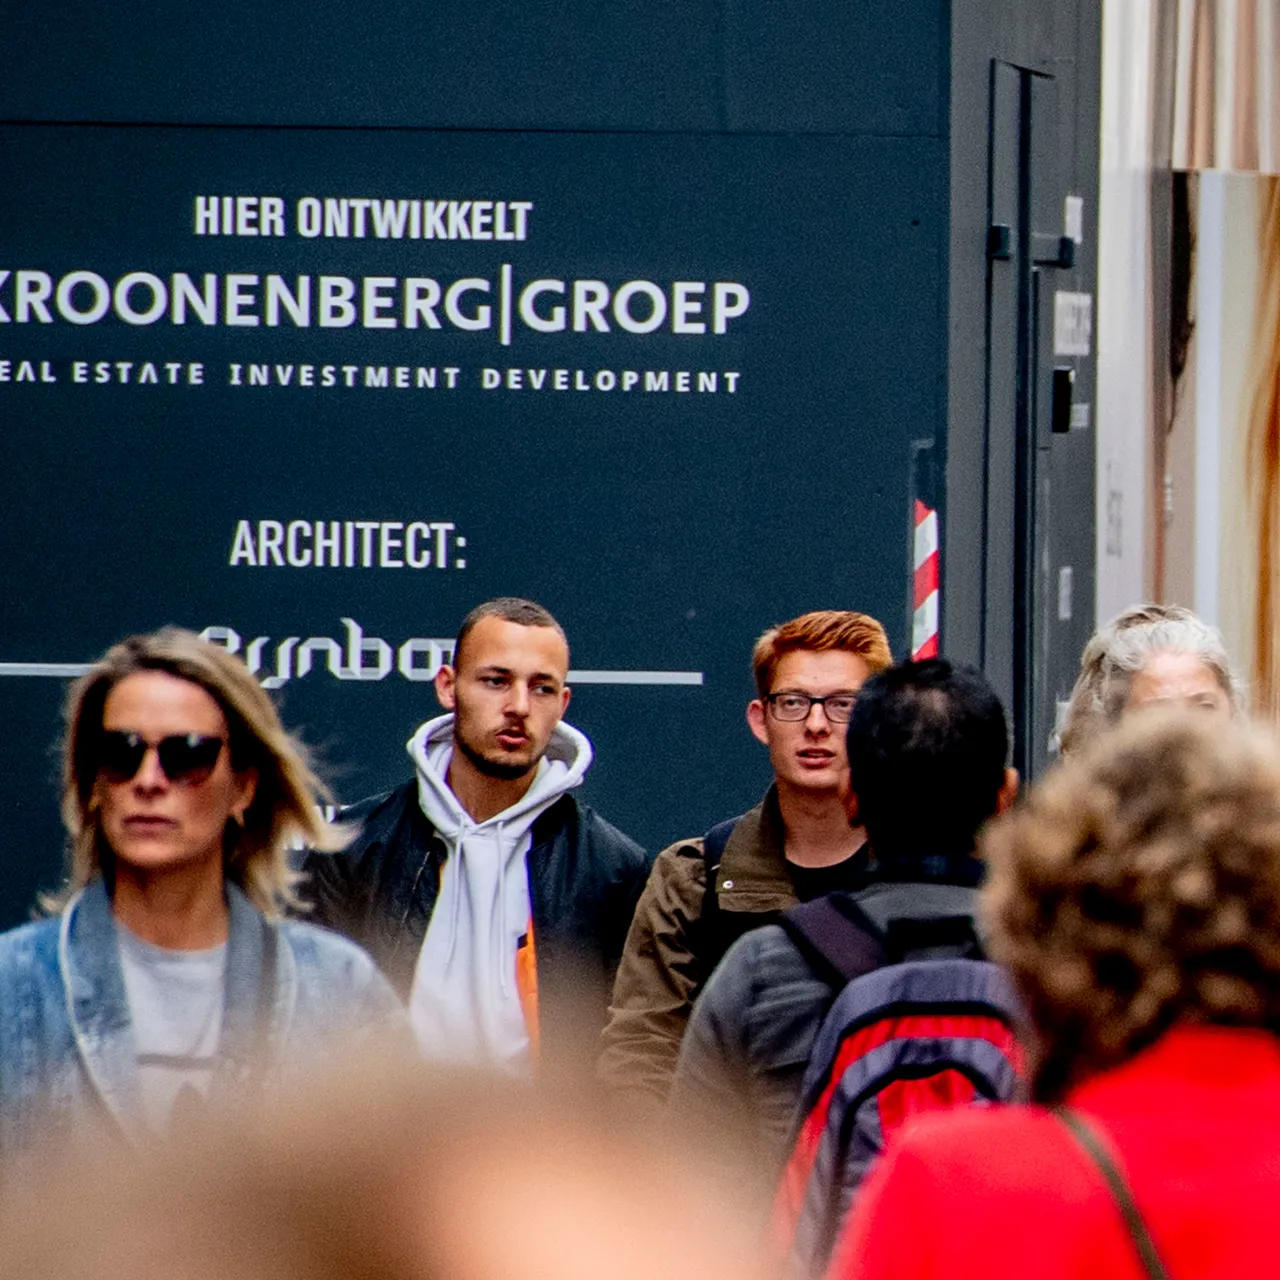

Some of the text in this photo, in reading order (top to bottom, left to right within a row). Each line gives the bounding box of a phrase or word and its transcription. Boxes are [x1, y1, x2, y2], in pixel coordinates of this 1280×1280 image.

[196, 196, 532, 240] HIER ONTWIKKELT
[0, 361, 740, 393] EAL ESTATE INVESTMENT DEVELOPMENT
[230, 520, 465, 568] ARCHITECT:
